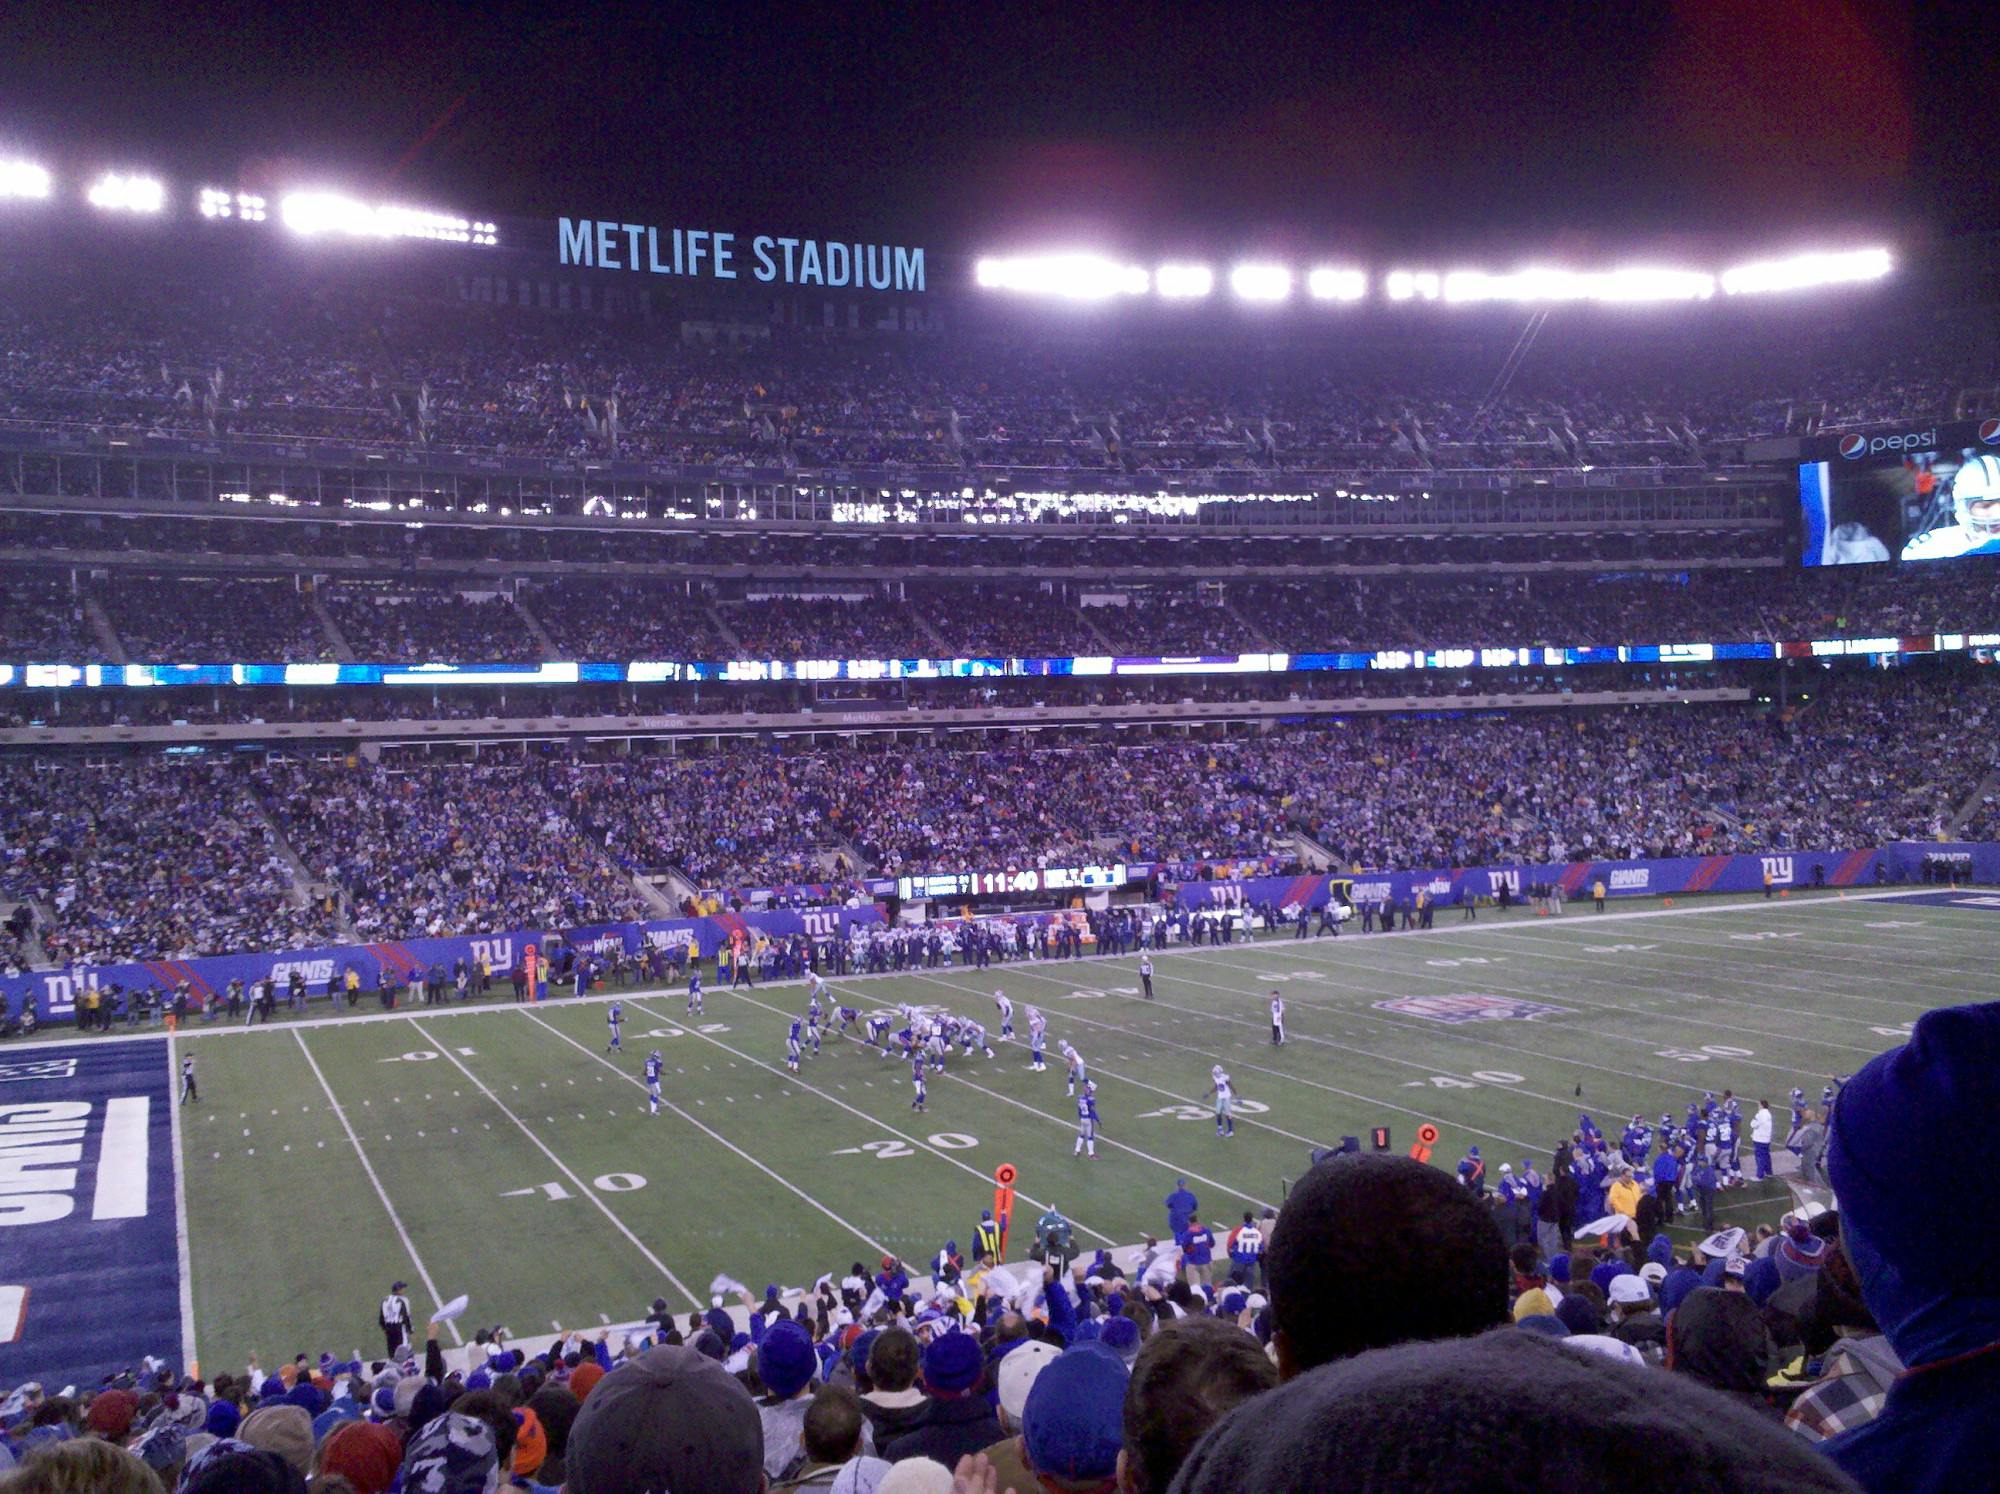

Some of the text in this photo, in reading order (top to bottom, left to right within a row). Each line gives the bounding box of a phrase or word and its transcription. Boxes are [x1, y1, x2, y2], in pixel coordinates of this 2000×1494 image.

[559, 217, 925, 292] METLIFE STADIUM
[1871, 428, 1936, 455] pepsi
[983, 871, 1038, 893] 11:40
[1610, 869, 1649, 885] GIANTS
